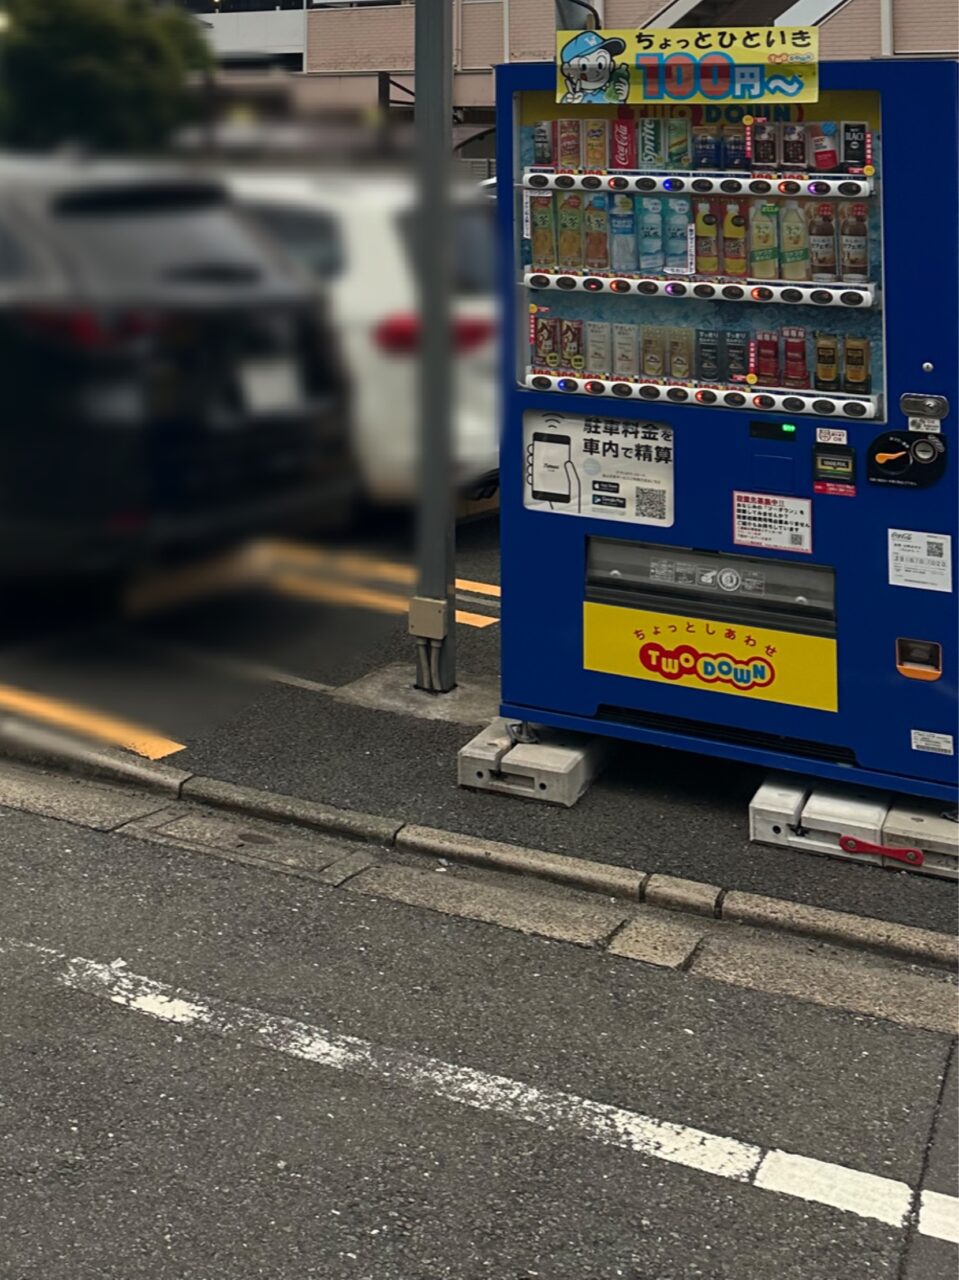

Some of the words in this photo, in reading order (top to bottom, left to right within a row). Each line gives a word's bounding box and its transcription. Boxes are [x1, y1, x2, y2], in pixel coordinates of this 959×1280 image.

[635, 30, 812, 50] ちょっとひといき
[643, 119, 655, 164] Sprite
[583, 417, 673, 442] 駐車料金を
[583, 438, 673, 464] 車内で精算
[633, 621, 777, 657] ちょっとしあわせ
[648, 650, 695, 674] TWO
[704, 661, 766, 684] DOWN
